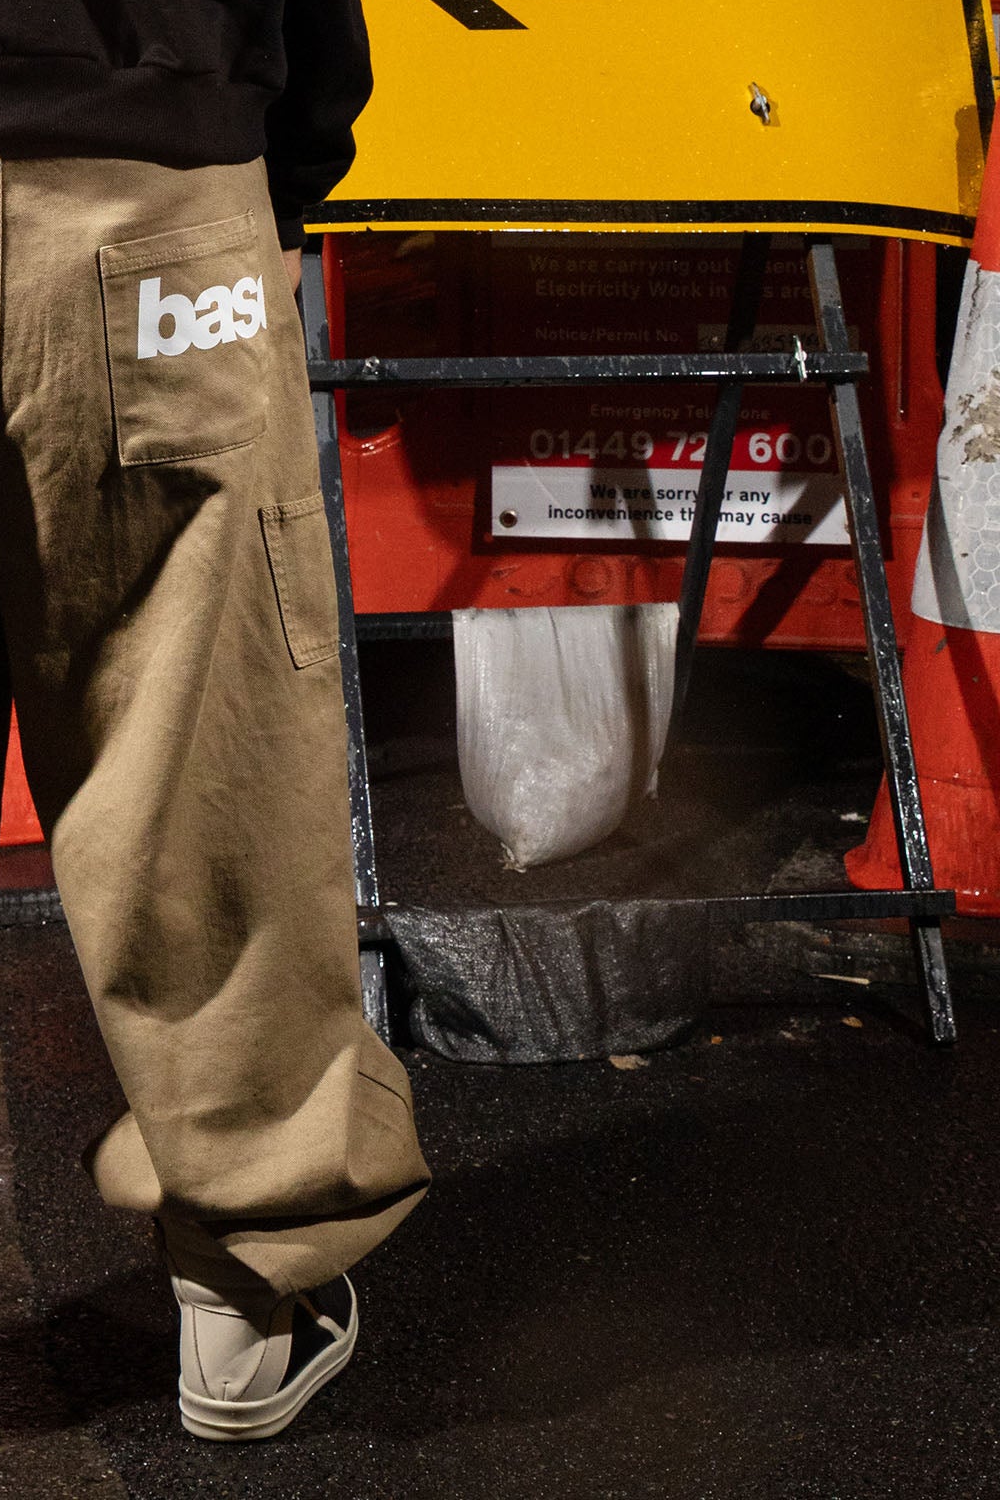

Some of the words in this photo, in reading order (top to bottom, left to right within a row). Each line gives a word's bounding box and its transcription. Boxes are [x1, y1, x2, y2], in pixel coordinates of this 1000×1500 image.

[528, 255, 560, 274] We
[566, 259, 598, 274] are
[605, 256, 690, 279] carrying
[697, 256, 731, 274] out
[535, 279, 641, 300] Electricity
[648, 280, 703, 299] Work
[710, 280, 729, 298] in
[137, 274, 268, 360] bas
[590, 403, 680, 423] Emergency
[686, 405, 770, 423] Telone
[530, 428, 655, 461] 01449
[666, 431, 722, 462] 72
[748, 432, 833, 465] 600
[590, 484, 616, 500] We
[622, 486, 651, 500] are
[739, 489, 771, 506] any
[547, 504, 674, 521] inconvenience
[717, 508, 753, 525] may
[761, 510, 813, 525] cause
